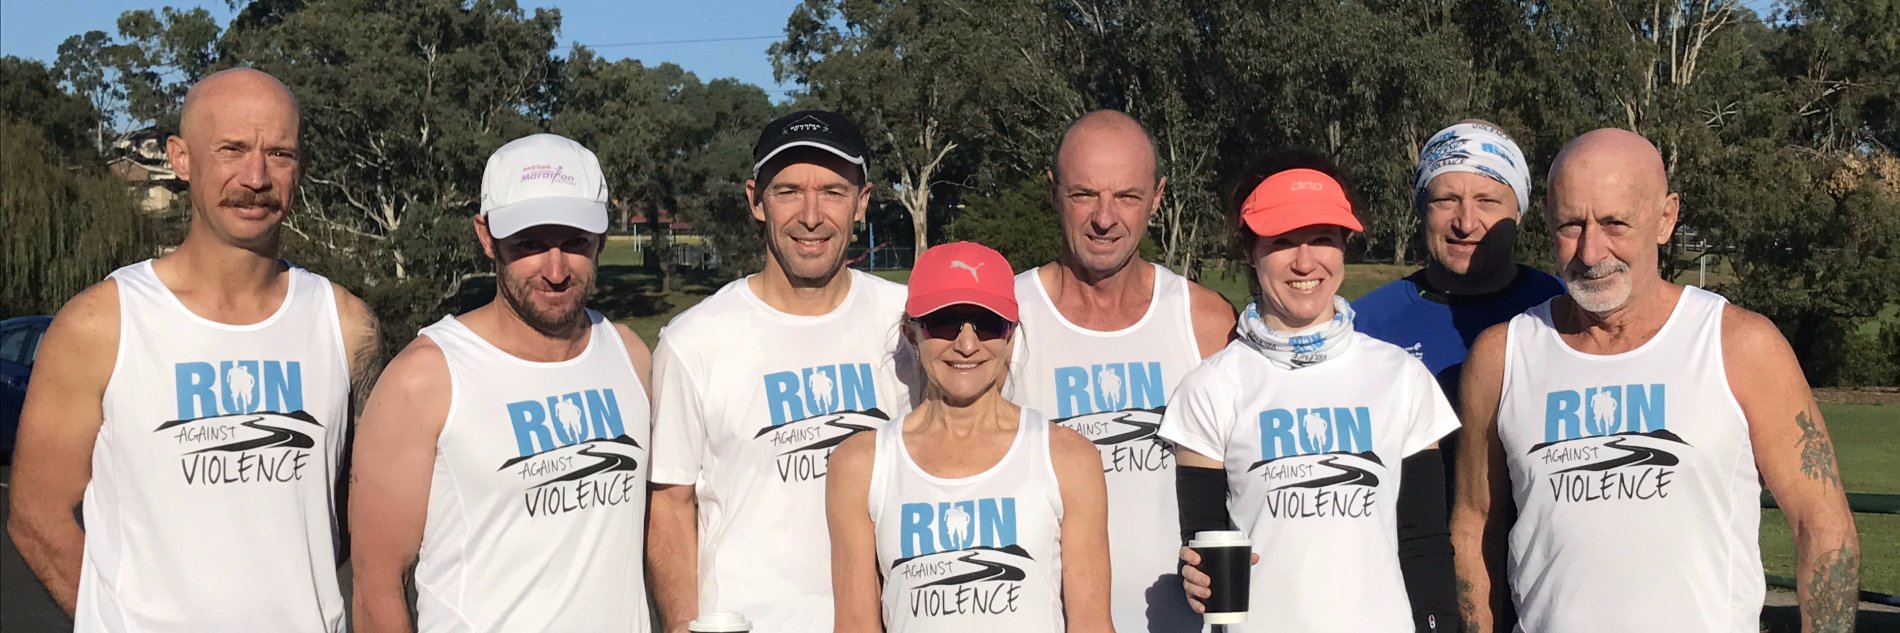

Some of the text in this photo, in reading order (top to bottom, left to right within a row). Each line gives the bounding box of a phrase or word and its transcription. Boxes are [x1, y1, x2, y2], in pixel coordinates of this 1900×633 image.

[175, 360, 304, 421] RUN
[763, 363, 878, 426] RUN
[1055, 362, 1166, 418] RUN
[506, 388, 626, 457] RUN
[1544, 384, 1665, 443] RUN
[173, 425, 237, 444] AGAINST
[770, 426, 822, 446] AGAINST
[1259, 407, 1373, 461] RUN
[181, 450, 311, 485] VIOLENCE
[518, 456, 574, 479] AGAINST
[777, 448, 831, 483] VIOL
[1261, 463, 1314, 482] AGAINST
[1542, 446, 1599, 464] AGAINST
[525, 473, 635, 517] VIOLENCE
[1549, 467, 1675, 502] VIOLENCE
[1267, 488, 1376, 518] VIOLENCE
[901, 497, 1017, 558] RUN
[902, 561, 953, 580] AGAINST
[910, 582, 1021, 617] VIOLENCE
